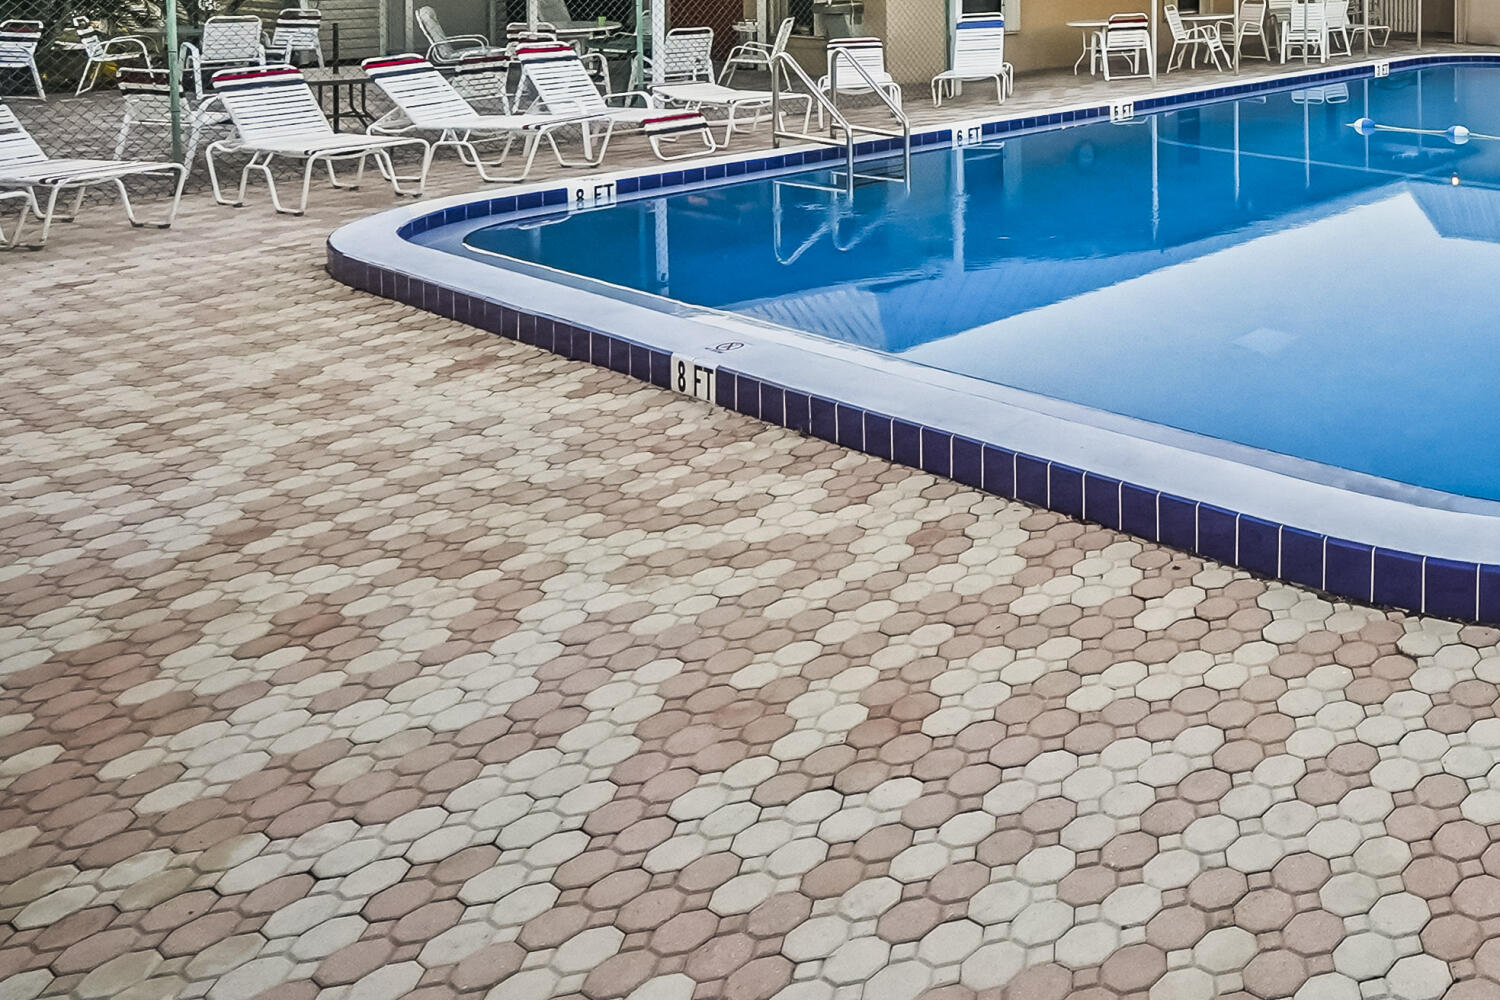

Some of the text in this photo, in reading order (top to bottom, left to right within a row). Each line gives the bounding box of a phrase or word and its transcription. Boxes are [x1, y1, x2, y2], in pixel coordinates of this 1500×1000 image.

[968, 126, 980, 143] FT
[594, 183, 614, 203] FT
[678, 360, 714, 400] 8 FT
